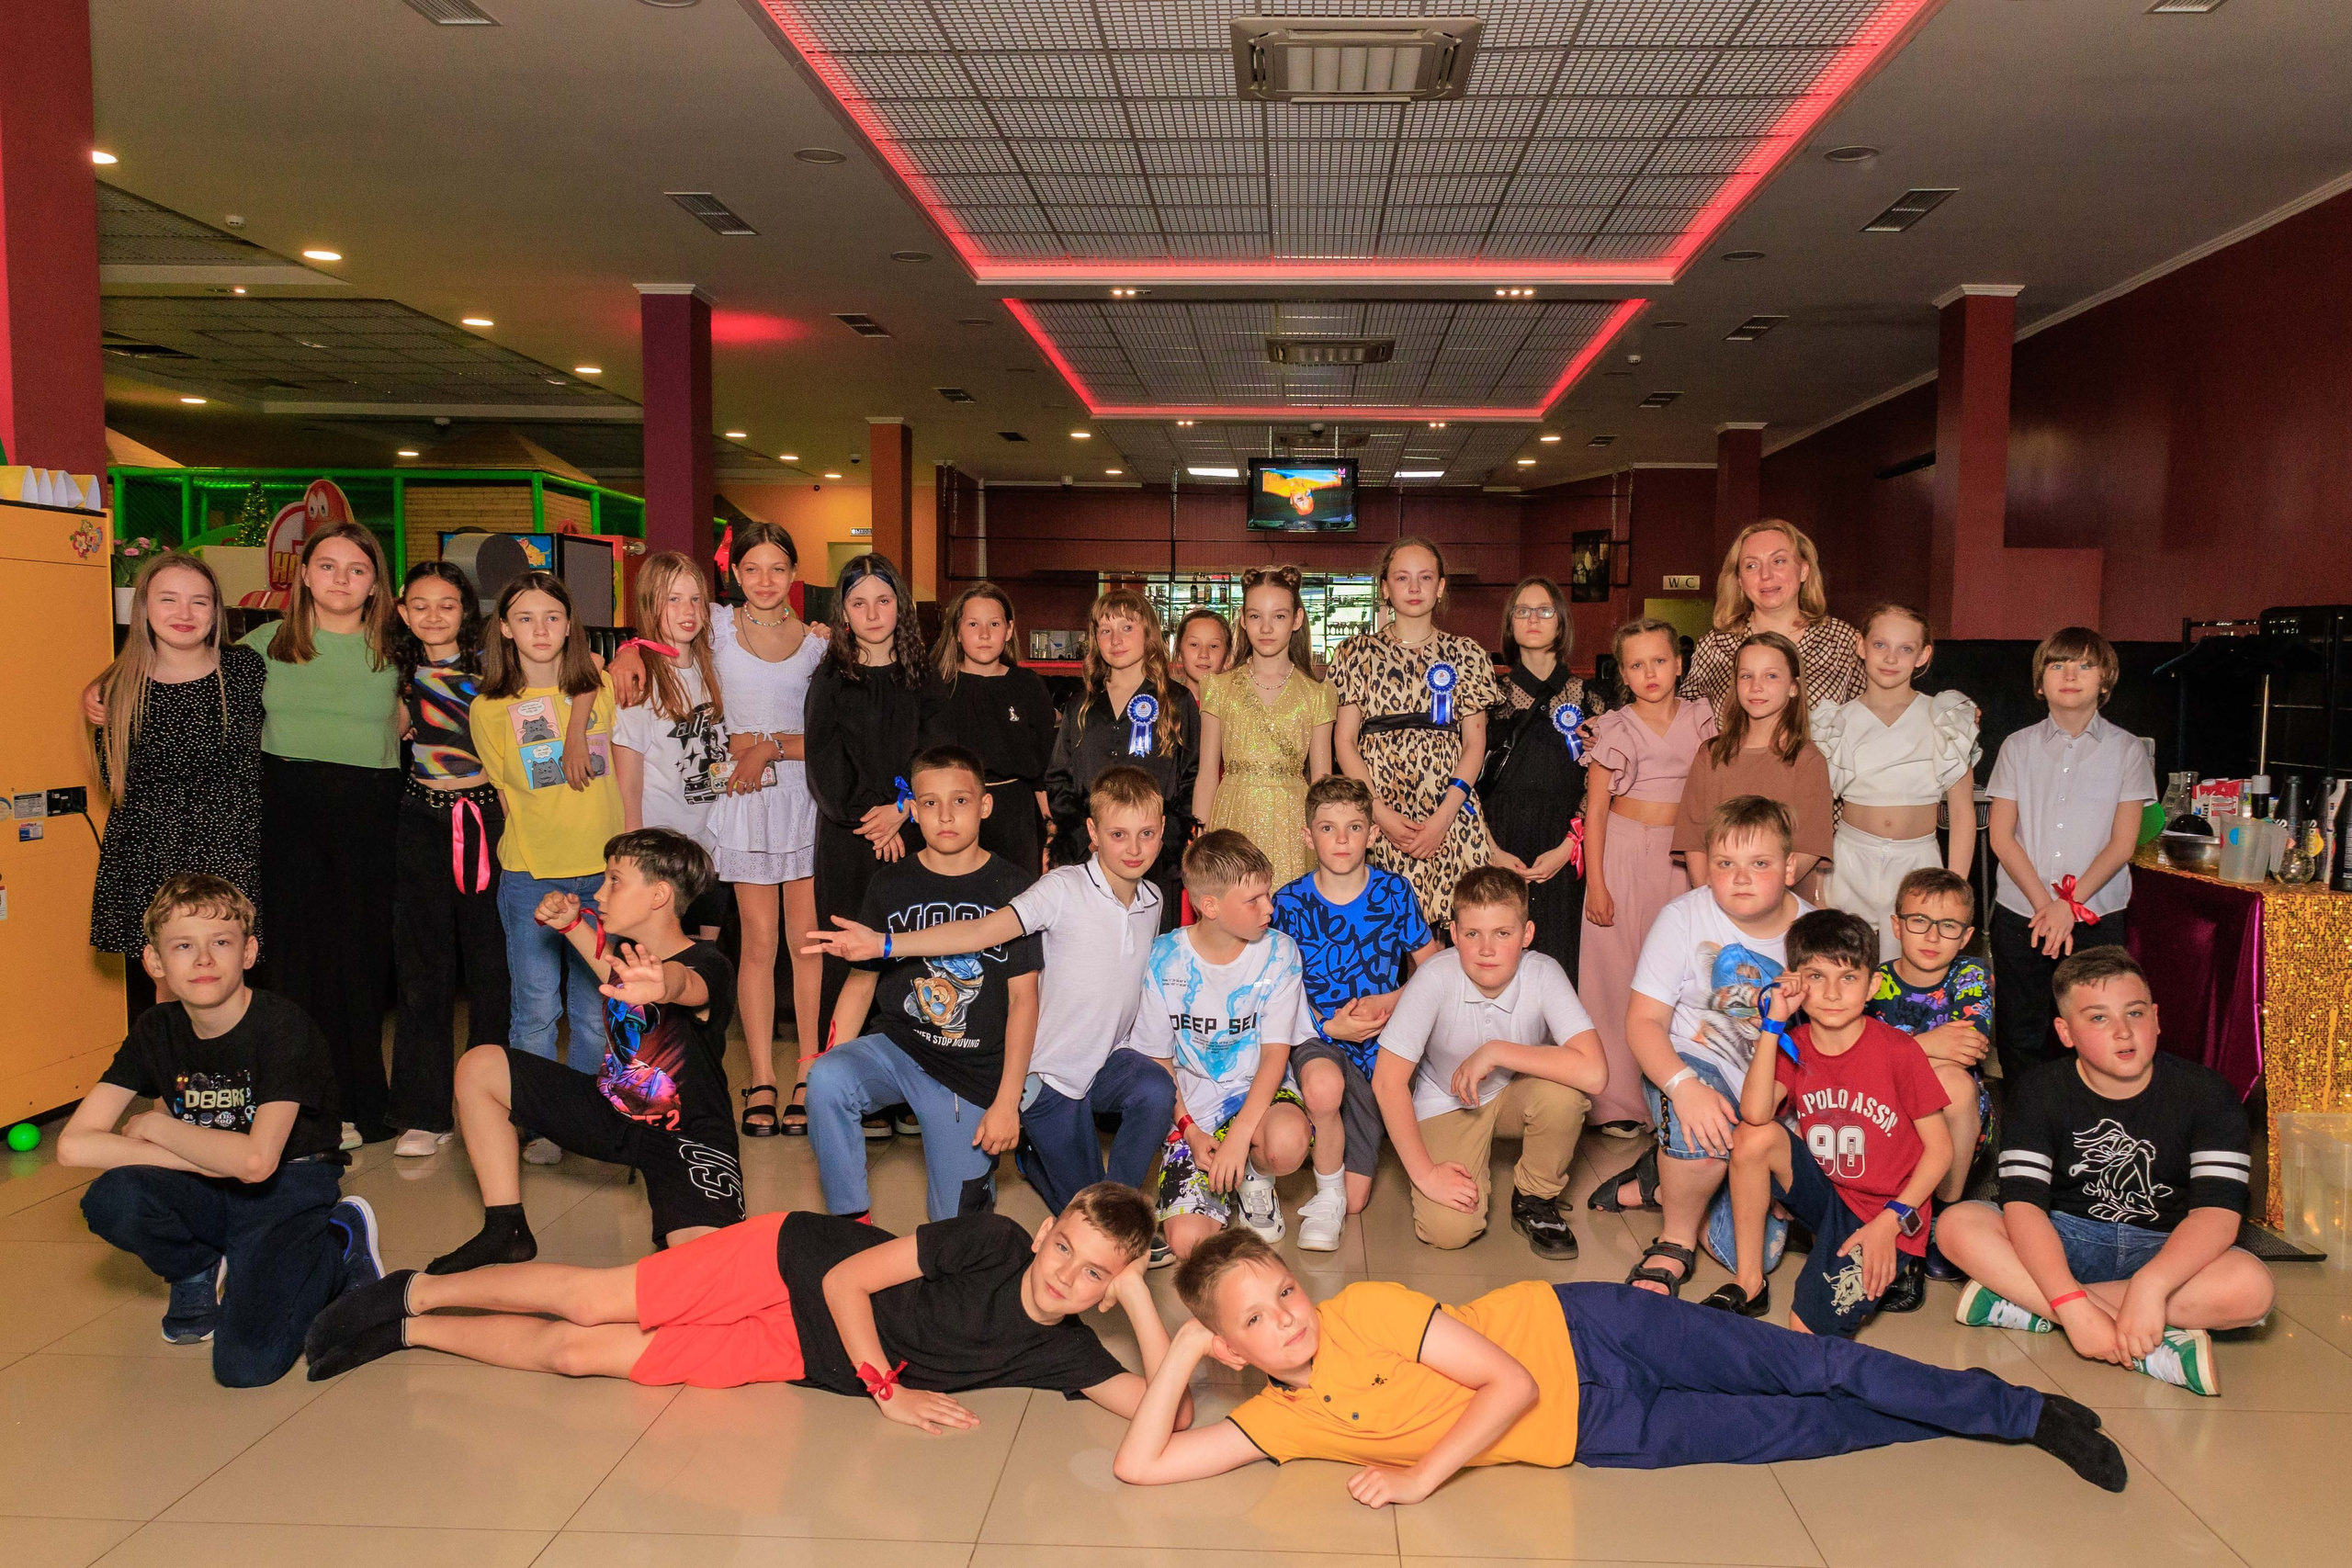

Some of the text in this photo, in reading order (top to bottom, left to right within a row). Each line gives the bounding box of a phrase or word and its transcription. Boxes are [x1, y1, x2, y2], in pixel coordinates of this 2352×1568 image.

[933, 1034, 952, 1047] STOP
[952, 1038, 980, 1048] MOVING
[1169, 1013, 1217, 1035] DEEP
[1802, 1088, 1898, 1137] POLO ASSN.
[1806, 1123, 1866, 1179] 90
